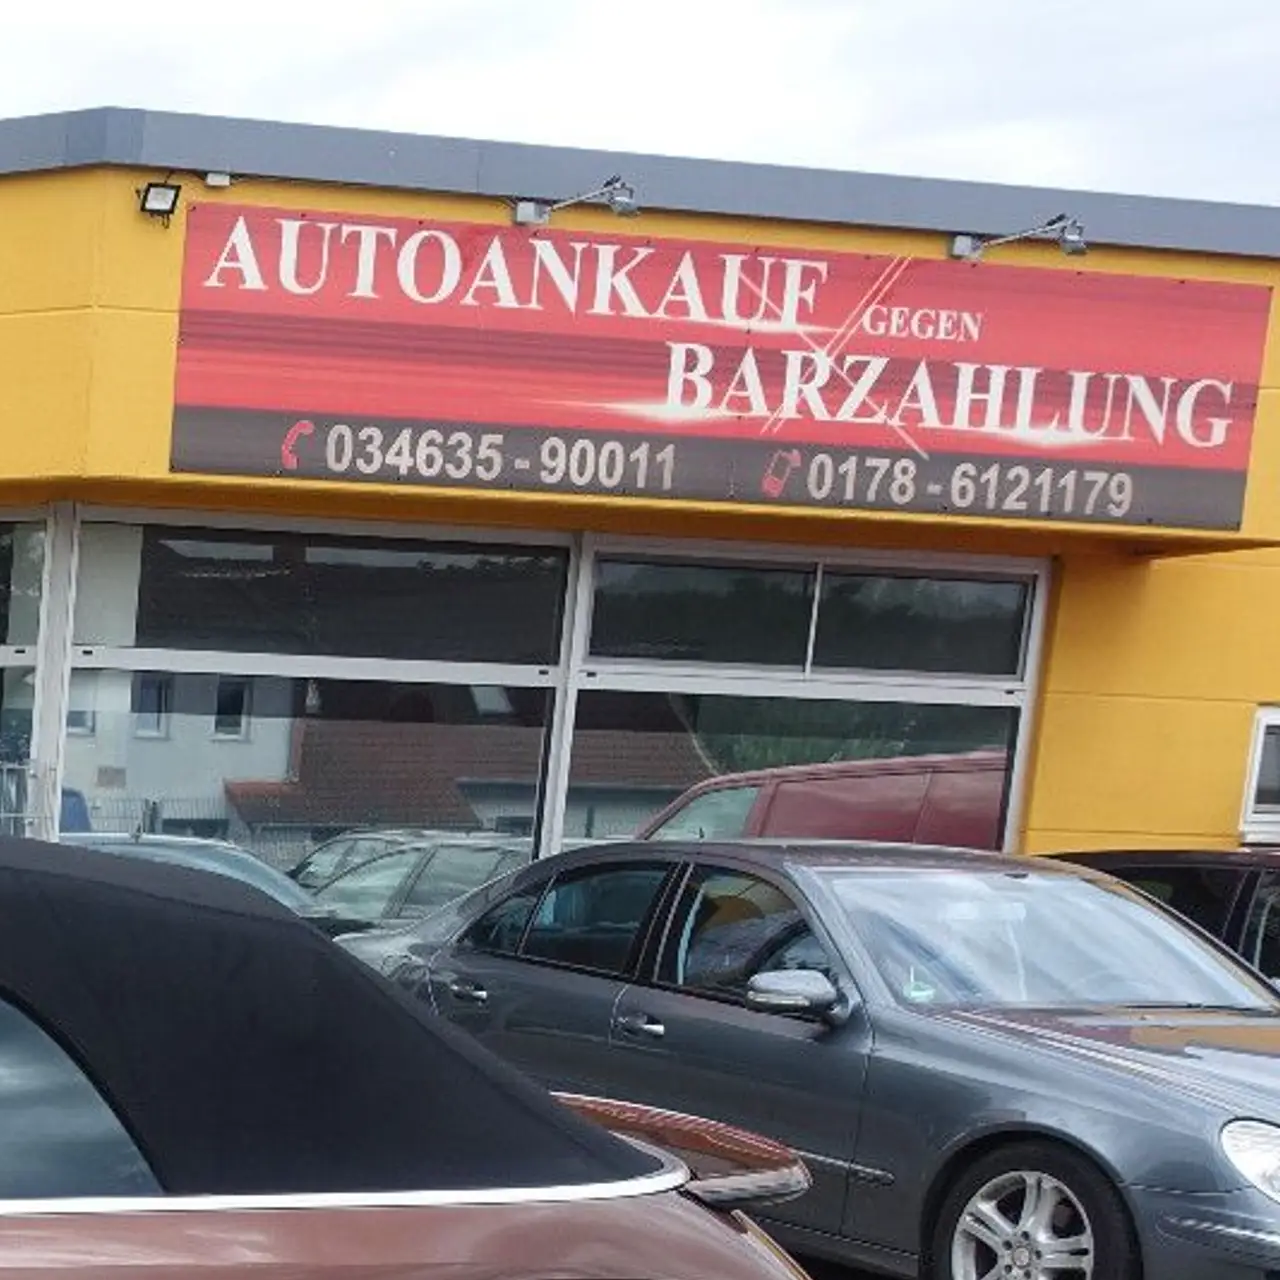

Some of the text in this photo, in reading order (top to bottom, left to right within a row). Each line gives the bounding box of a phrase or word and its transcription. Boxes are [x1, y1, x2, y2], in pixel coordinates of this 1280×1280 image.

[203, 215, 828, 331] AUTOANKAUF
[861, 306, 985, 342] GEGEN
[665, 341, 1234, 448] BARZAHLUNG
